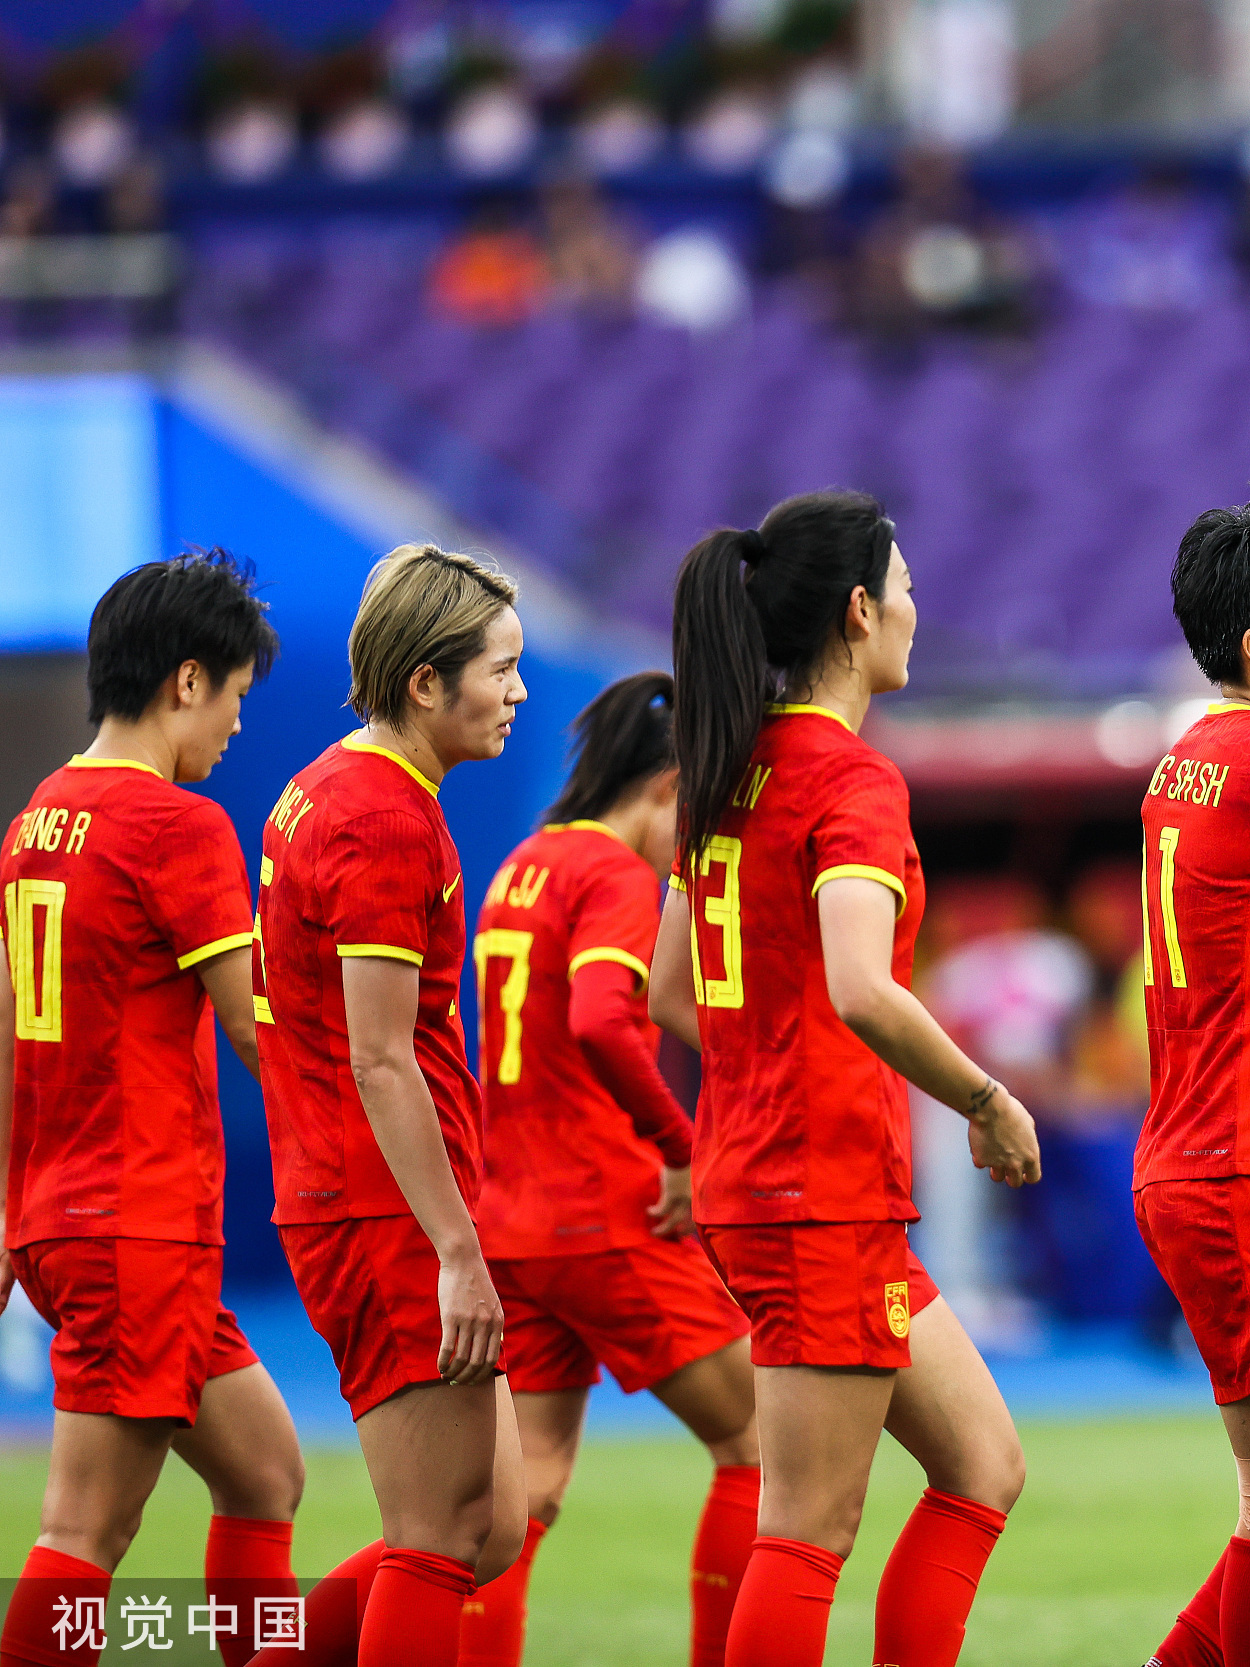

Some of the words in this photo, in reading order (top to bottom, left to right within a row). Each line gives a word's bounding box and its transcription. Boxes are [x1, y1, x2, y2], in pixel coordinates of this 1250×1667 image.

[65, 810, 92, 855] R
[284, 797, 315, 843] X
[1167, 758, 1230, 808] SHSH
[690, 832, 745, 1009] 13
[1141, 824, 1188, 989] 11
[4, 878, 67, 1043] 10
